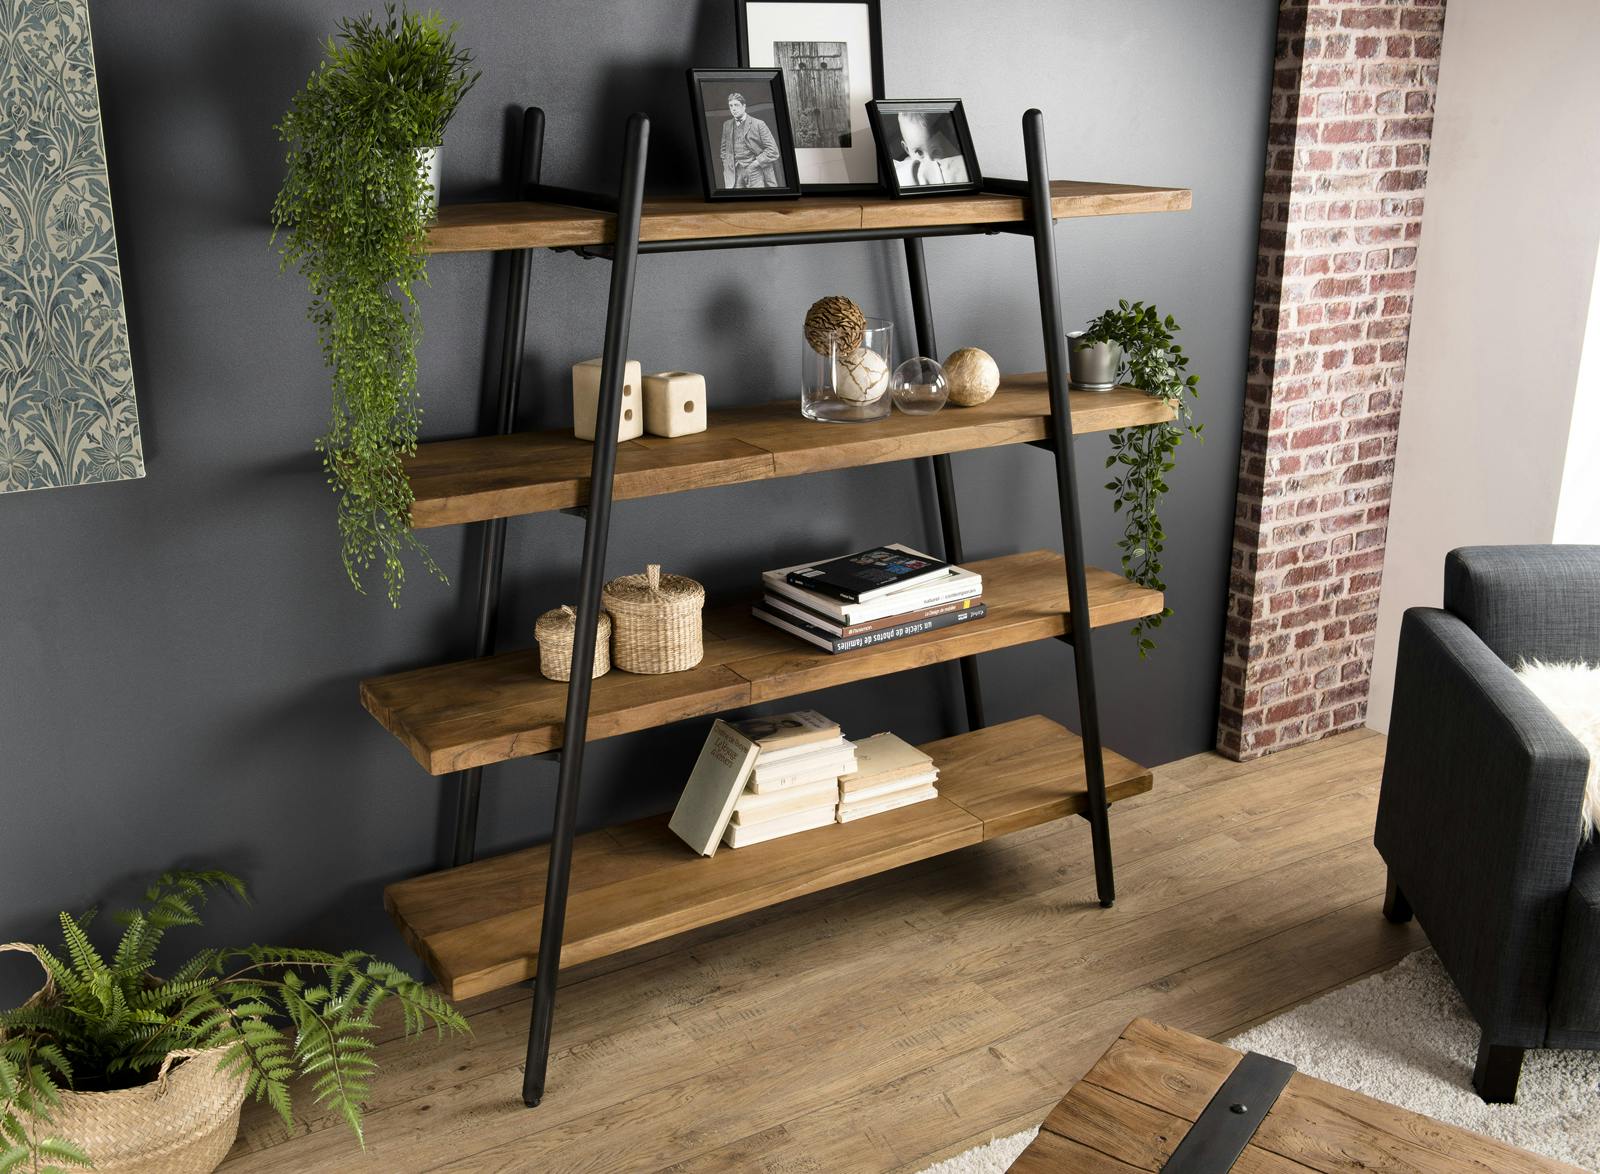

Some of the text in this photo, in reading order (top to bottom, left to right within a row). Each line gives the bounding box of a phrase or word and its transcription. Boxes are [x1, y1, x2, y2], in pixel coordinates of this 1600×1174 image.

[923, 621, 932, 630] un
[873, 629, 895, 642] photos
[896, 628, 904, 637] de
[837, 638, 862, 650] familles
[864, 635, 872, 645] de
